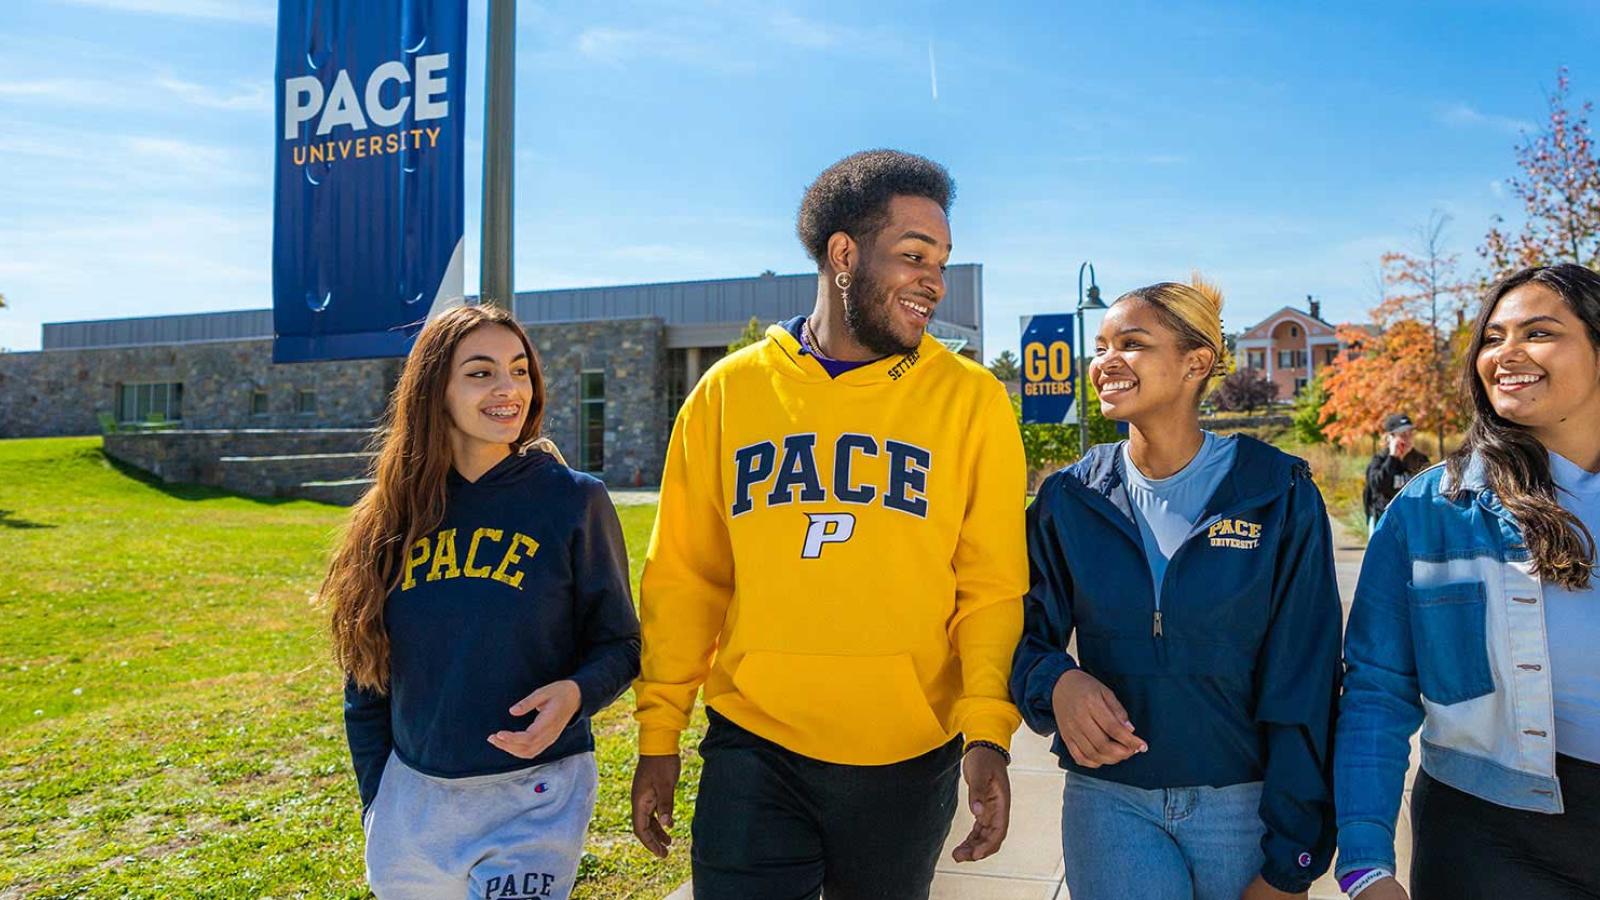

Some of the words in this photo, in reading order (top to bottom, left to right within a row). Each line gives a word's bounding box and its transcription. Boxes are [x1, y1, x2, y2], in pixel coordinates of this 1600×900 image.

[284, 53, 449, 140] PACE
[293, 127, 441, 166] UNIVERSITY
[1024, 340, 1071, 382] GO
[1024, 381, 1073, 396] GETTERS
[732, 432, 931, 519] PACE
[800, 512, 857, 559] P
[1208, 519, 1262, 538] PACE
[1210, 537, 1259, 549] UNIVERSITY
[401, 527, 540, 592] PACE
[485, 872, 555, 900] PACE
